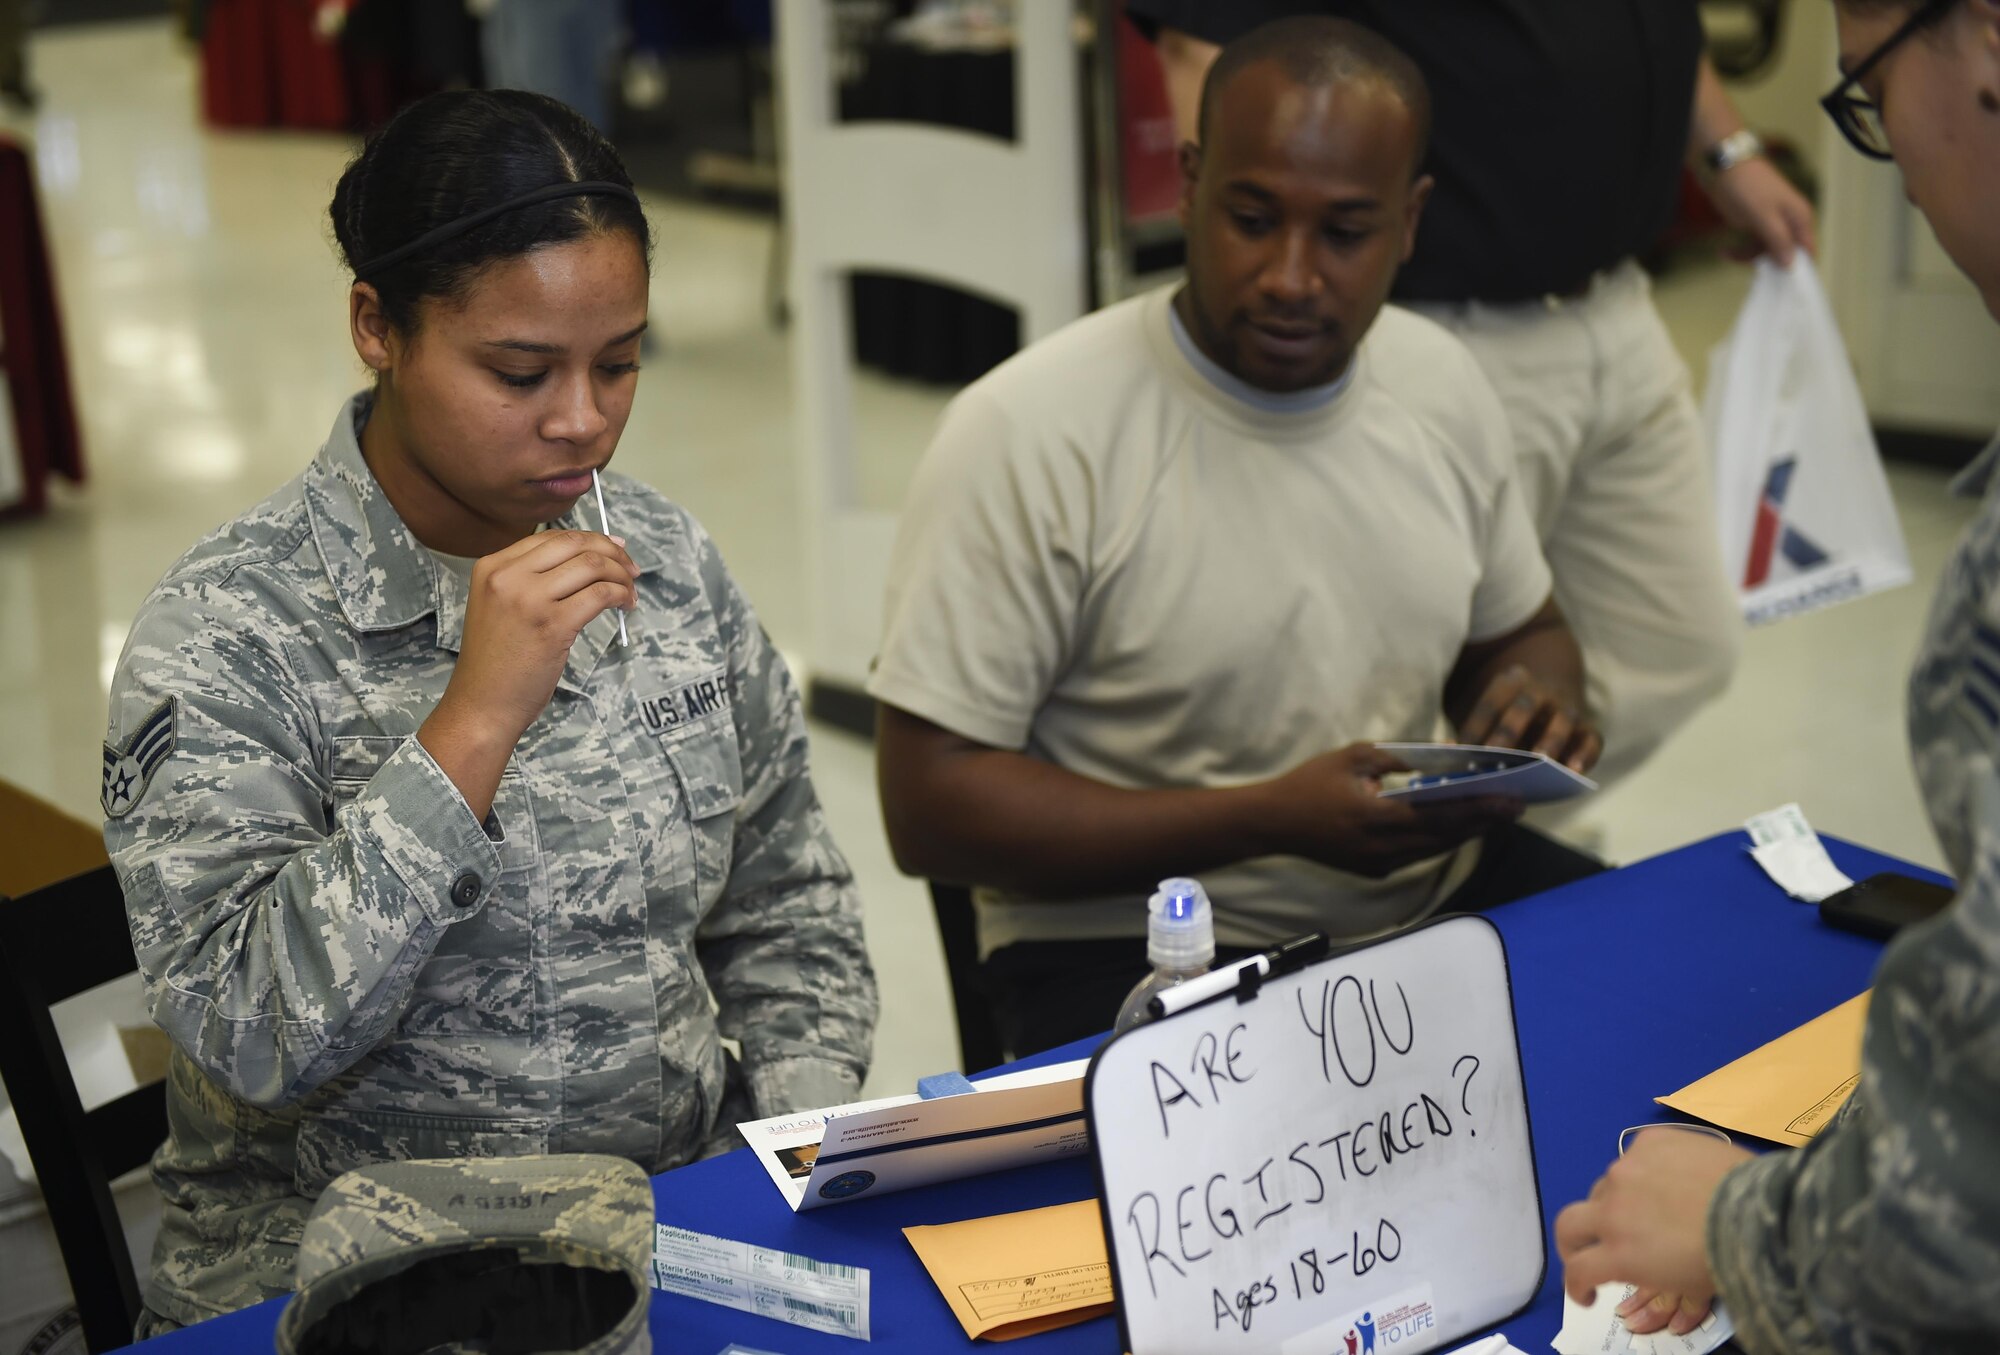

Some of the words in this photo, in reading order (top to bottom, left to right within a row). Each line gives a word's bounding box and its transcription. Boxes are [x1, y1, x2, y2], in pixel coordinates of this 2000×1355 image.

[642, 697, 684, 728] U.S.
[1150, 1022, 1257, 1139] ARE
[1297, 975, 1413, 1087] YOU
[766, 1122, 795, 1132] LIFE
[1127, 1055, 1480, 1299] REGISTERED?
[660, 1228, 699, 1243] Applicators
[660, 1262, 683, 1273] Sterile
[684, 1269, 709, 1280] Cotton
[711, 1274, 734, 1286] Tipped
[1212, 1274, 1278, 1332] Ages
[1290, 1218, 1401, 1301] 18-60
[1381, 1326, 1401, 1347] TO
[1405, 1311, 1434, 1337] LIFE
